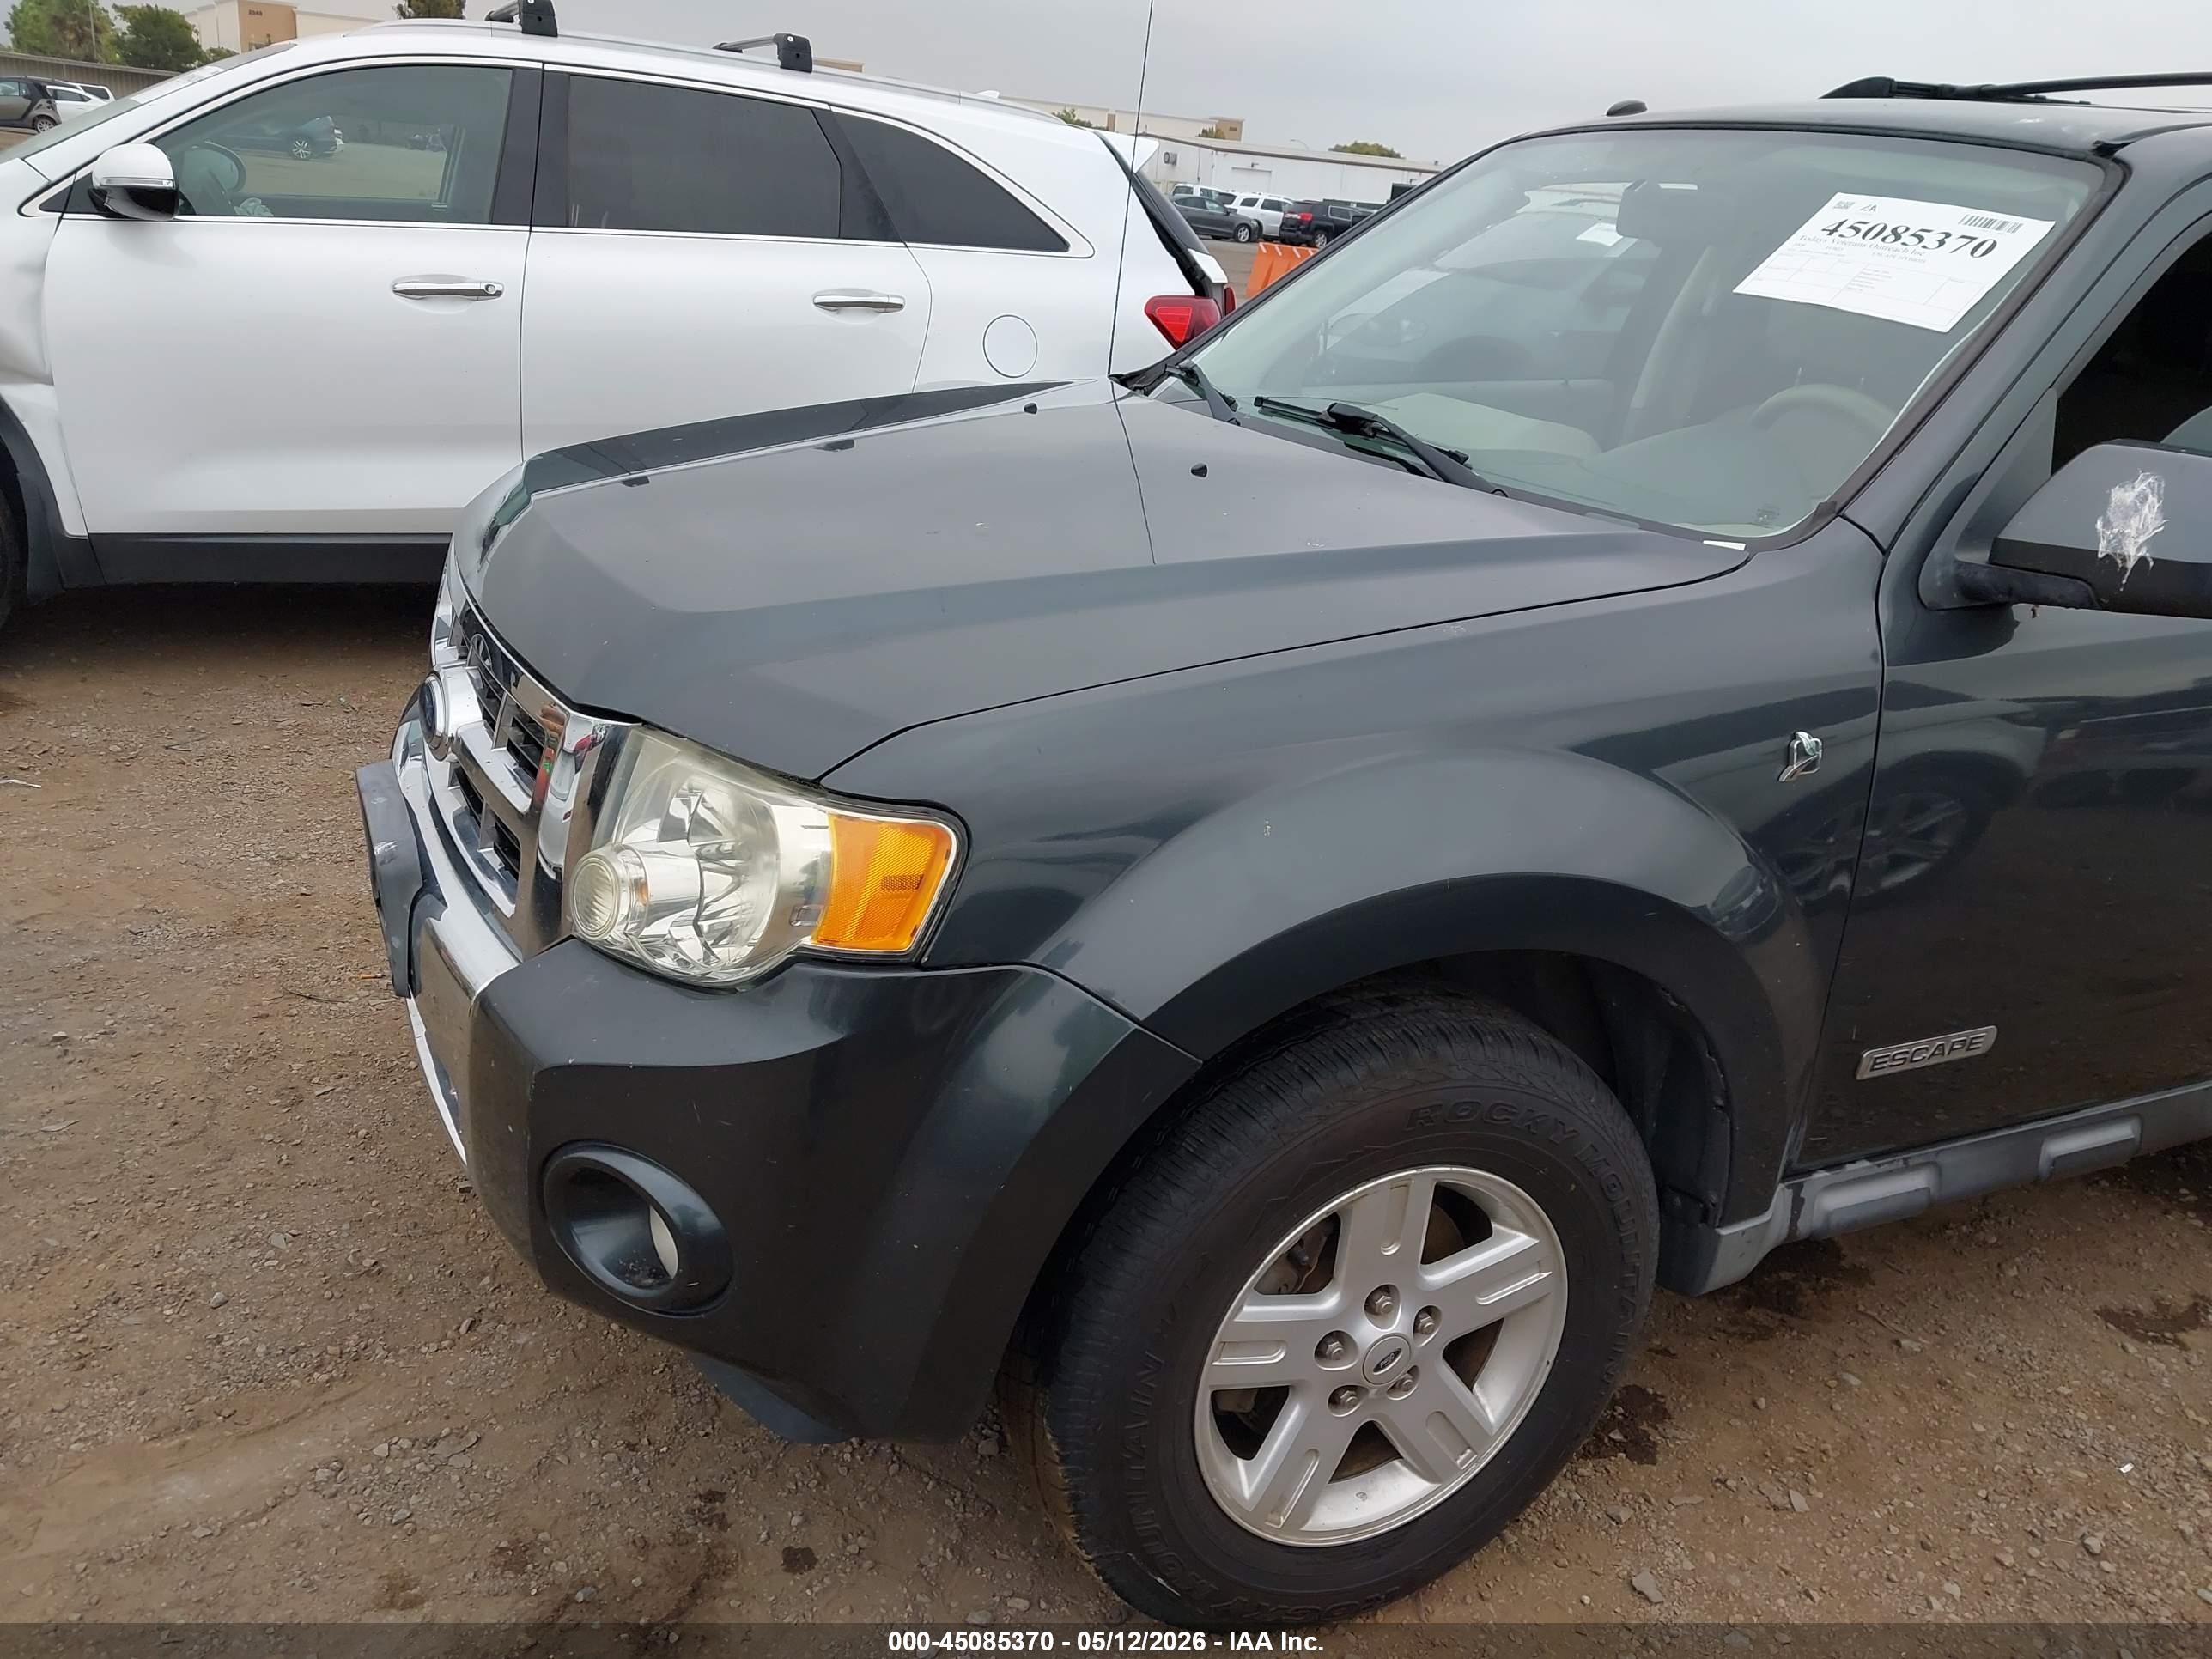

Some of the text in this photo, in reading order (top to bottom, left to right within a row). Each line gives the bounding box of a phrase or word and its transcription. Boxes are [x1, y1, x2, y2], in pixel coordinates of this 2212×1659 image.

[1821, 217, 1998, 259] 45085370
[1869, 1032, 1988, 1072] ESCAPE
[1404, 1098, 1580, 1145] ROCKY
